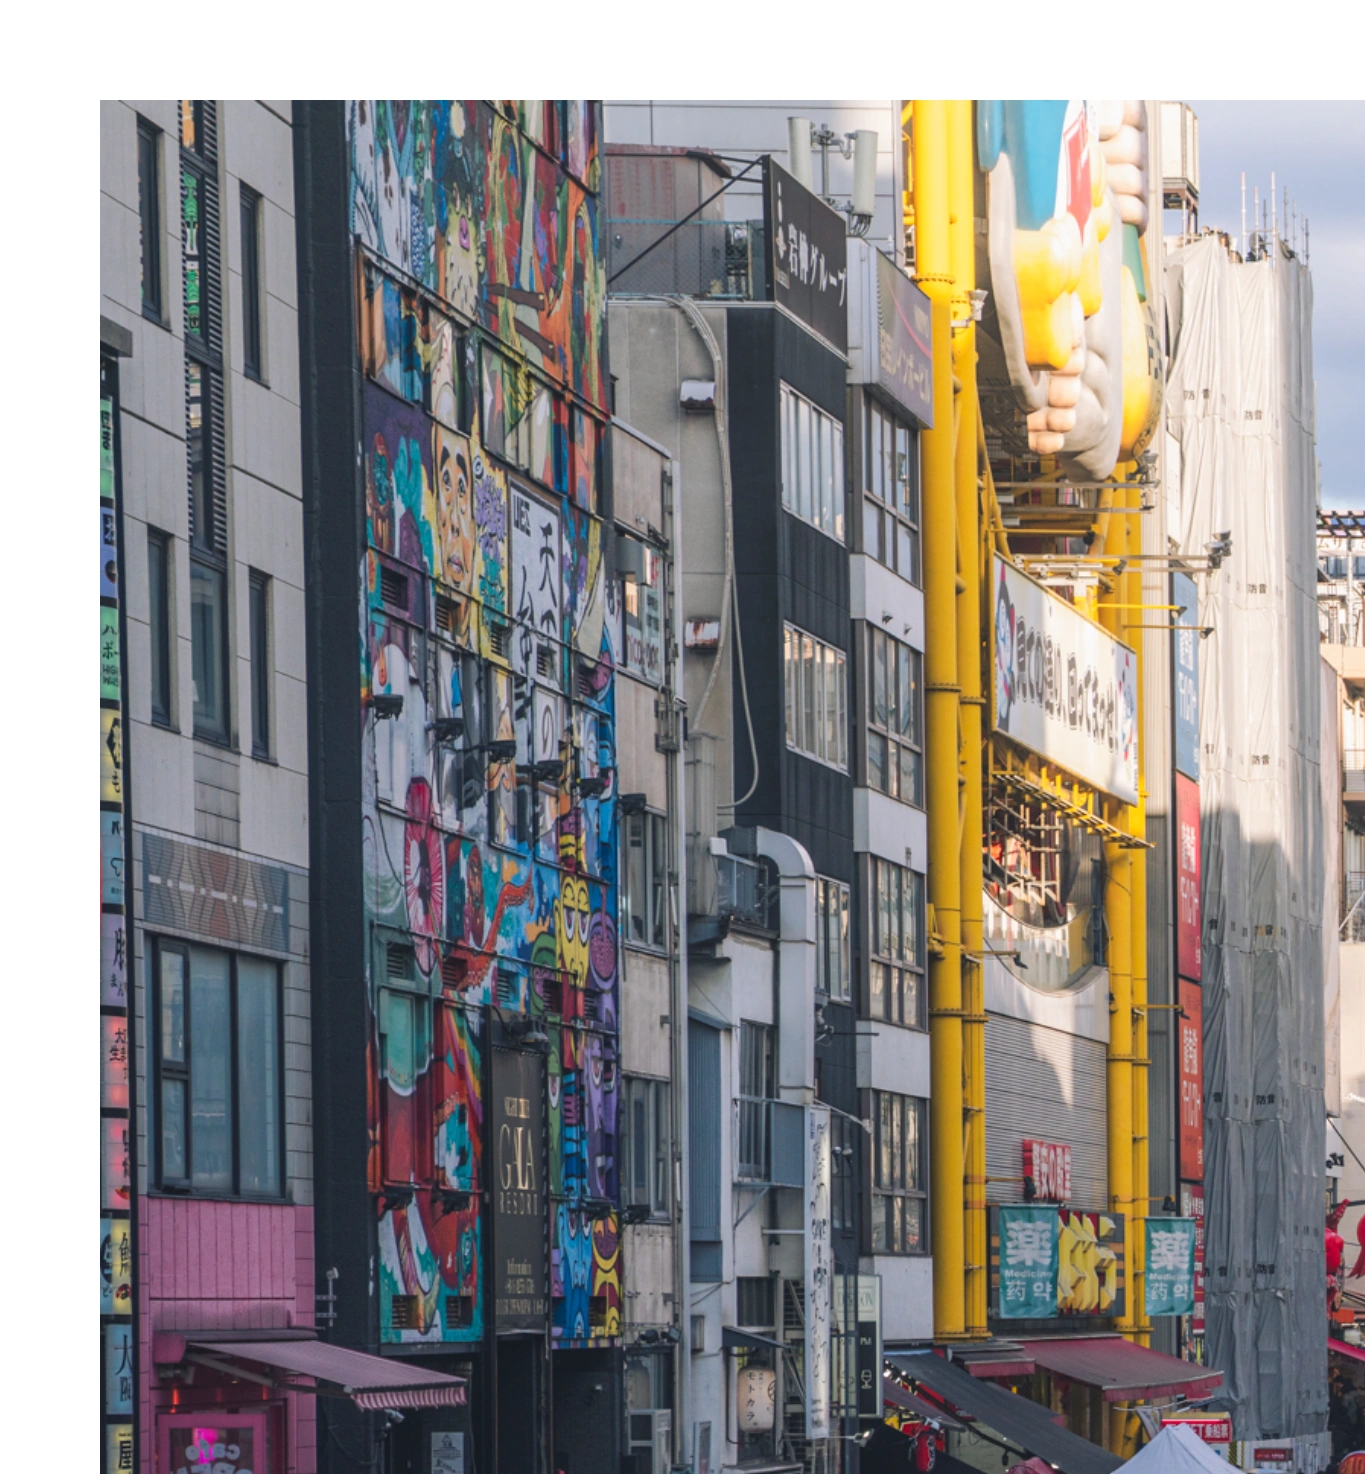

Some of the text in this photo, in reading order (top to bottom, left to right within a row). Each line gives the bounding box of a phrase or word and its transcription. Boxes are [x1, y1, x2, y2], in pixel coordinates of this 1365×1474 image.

[499, 1123, 537, 1191] GALA
[1006, 1219, 1052, 1266] 薬
[1150, 1230, 1190, 1271] 薬
[1004, 1269, 1053, 1279] Medicine
[1149, 1272, 1191, 1281] Medicine
[1005, 1281, 1027, 1301] 药
[1150, 1283, 1168, 1301] 药
[745, 1371, 757, 1422] モトカラ
